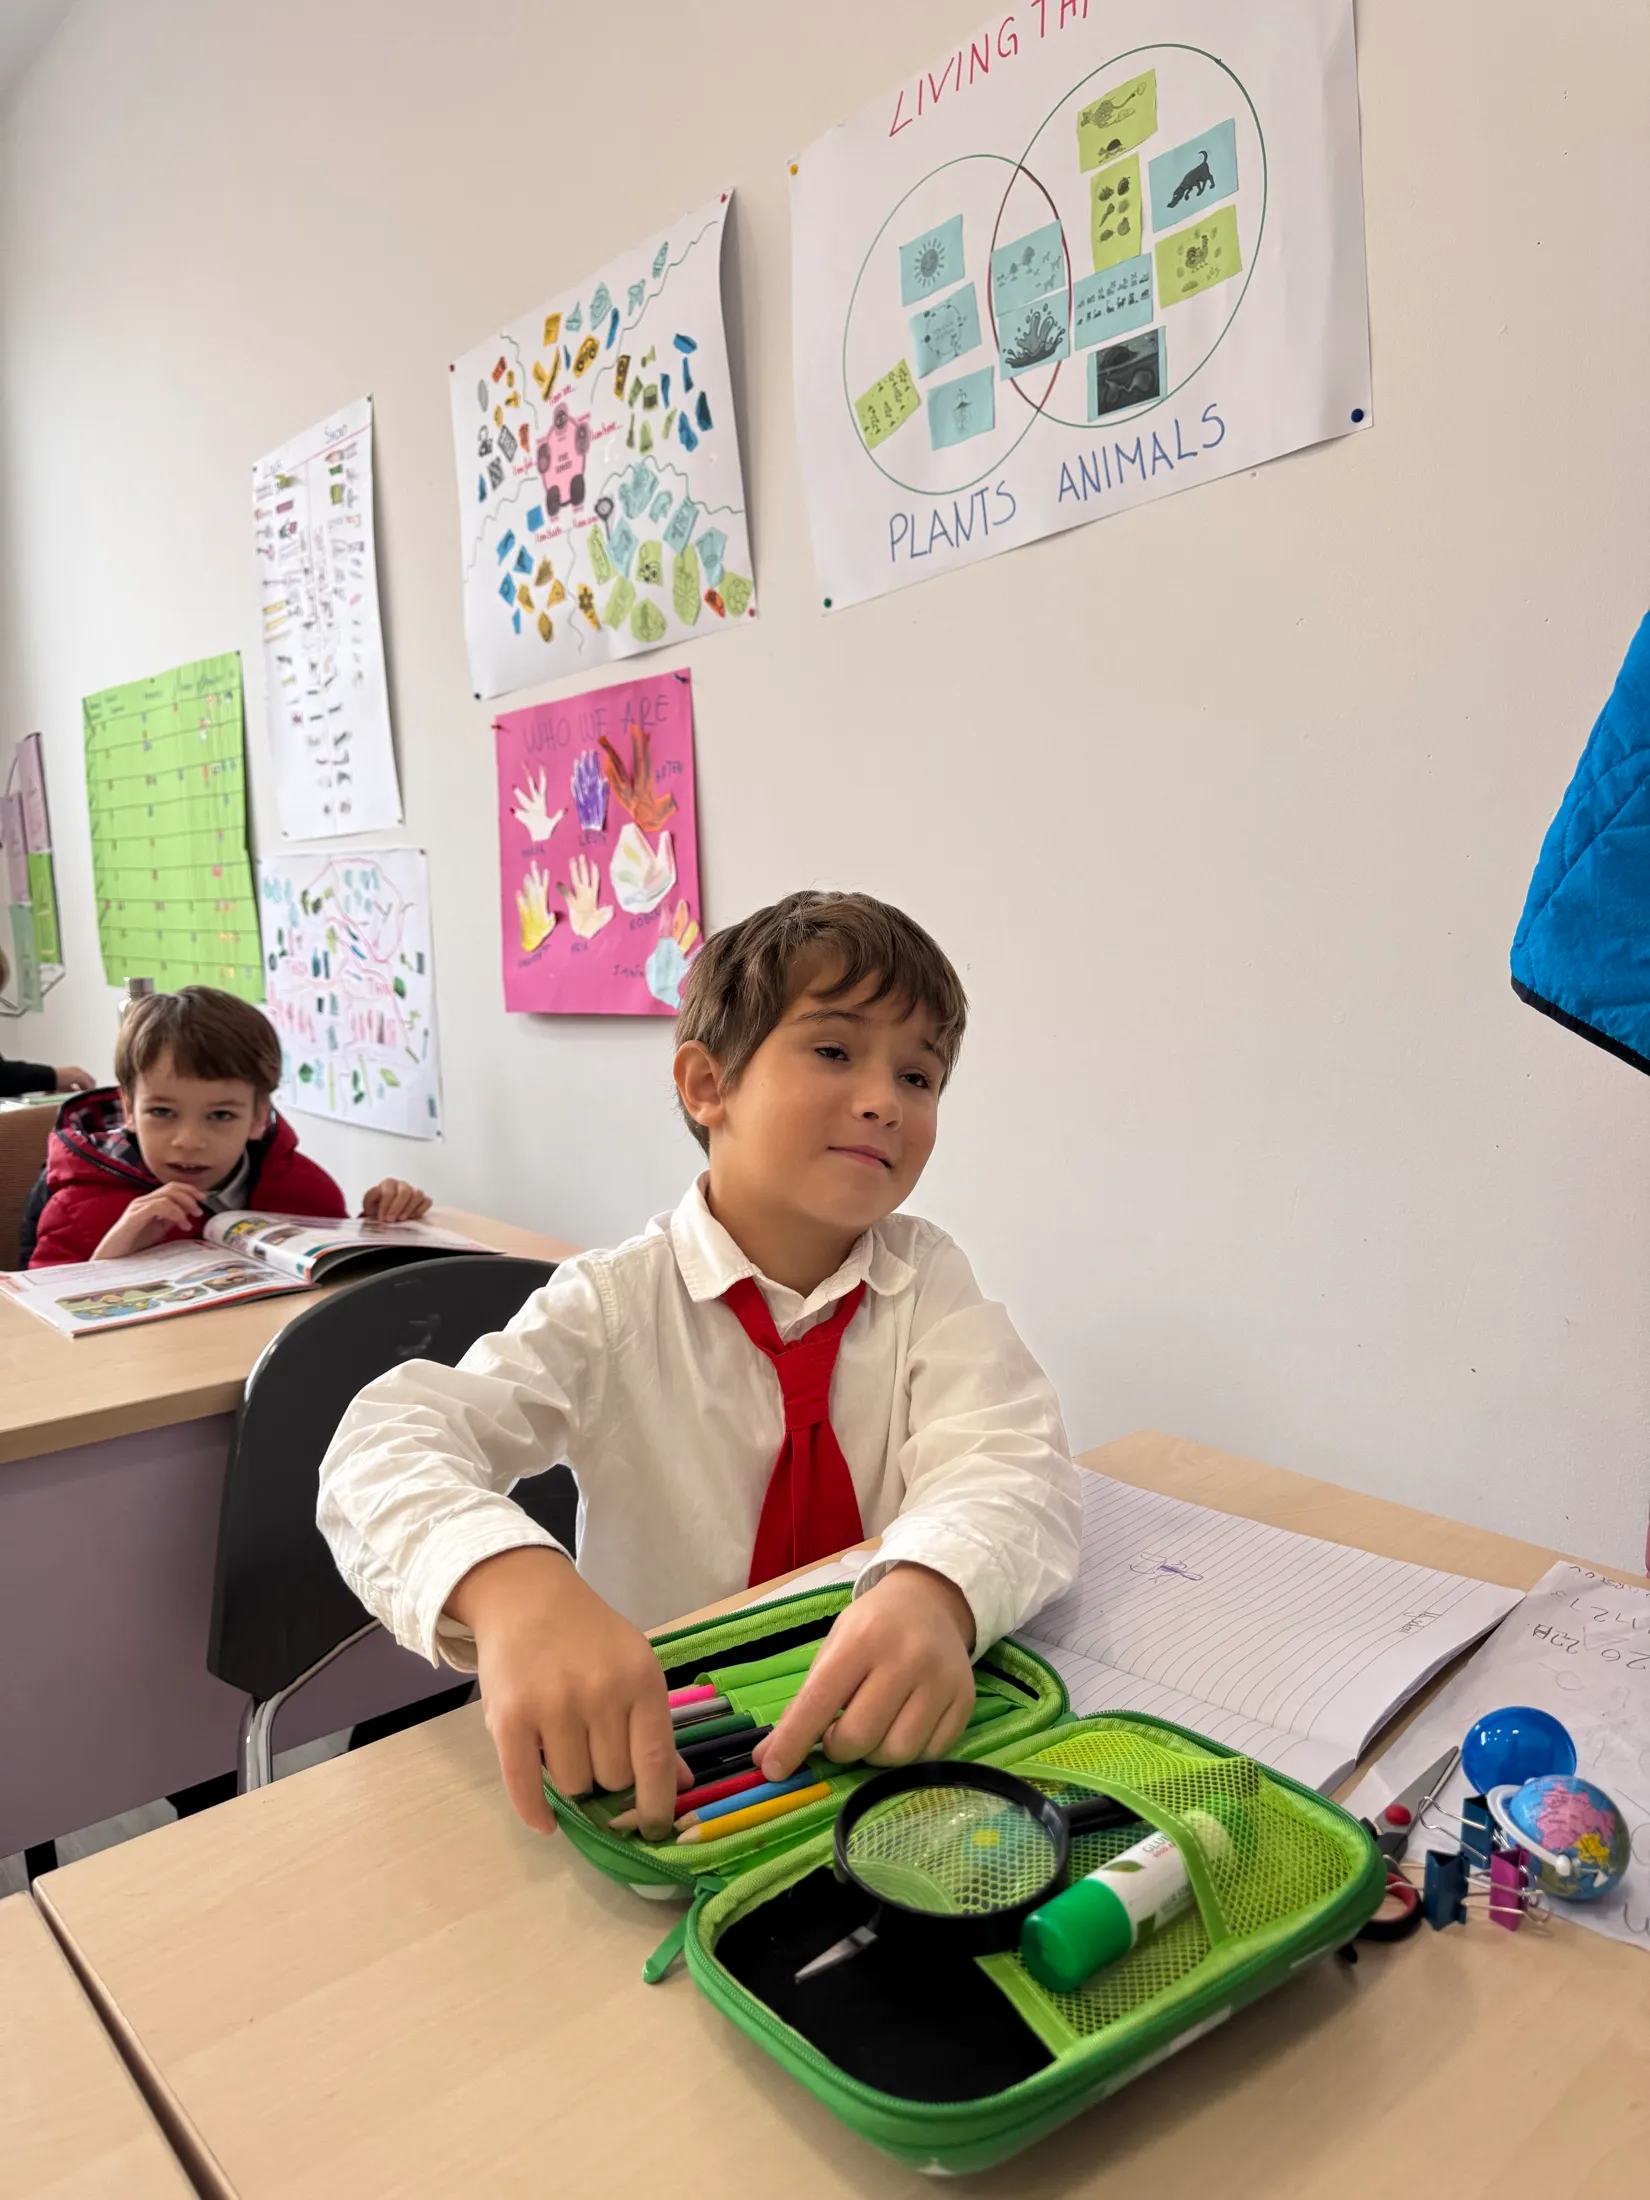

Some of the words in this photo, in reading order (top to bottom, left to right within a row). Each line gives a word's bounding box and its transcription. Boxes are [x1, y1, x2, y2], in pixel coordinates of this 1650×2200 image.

[889, 16, 1018, 138] LIVING
[1058, 402, 1226, 503] ANIMALS
[889, 480, 1017, 562] PLANTS
[522, 716, 571, 752] WHO
[578, 707, 609, 743] WE
[620, 694, 669, 734] ARE
